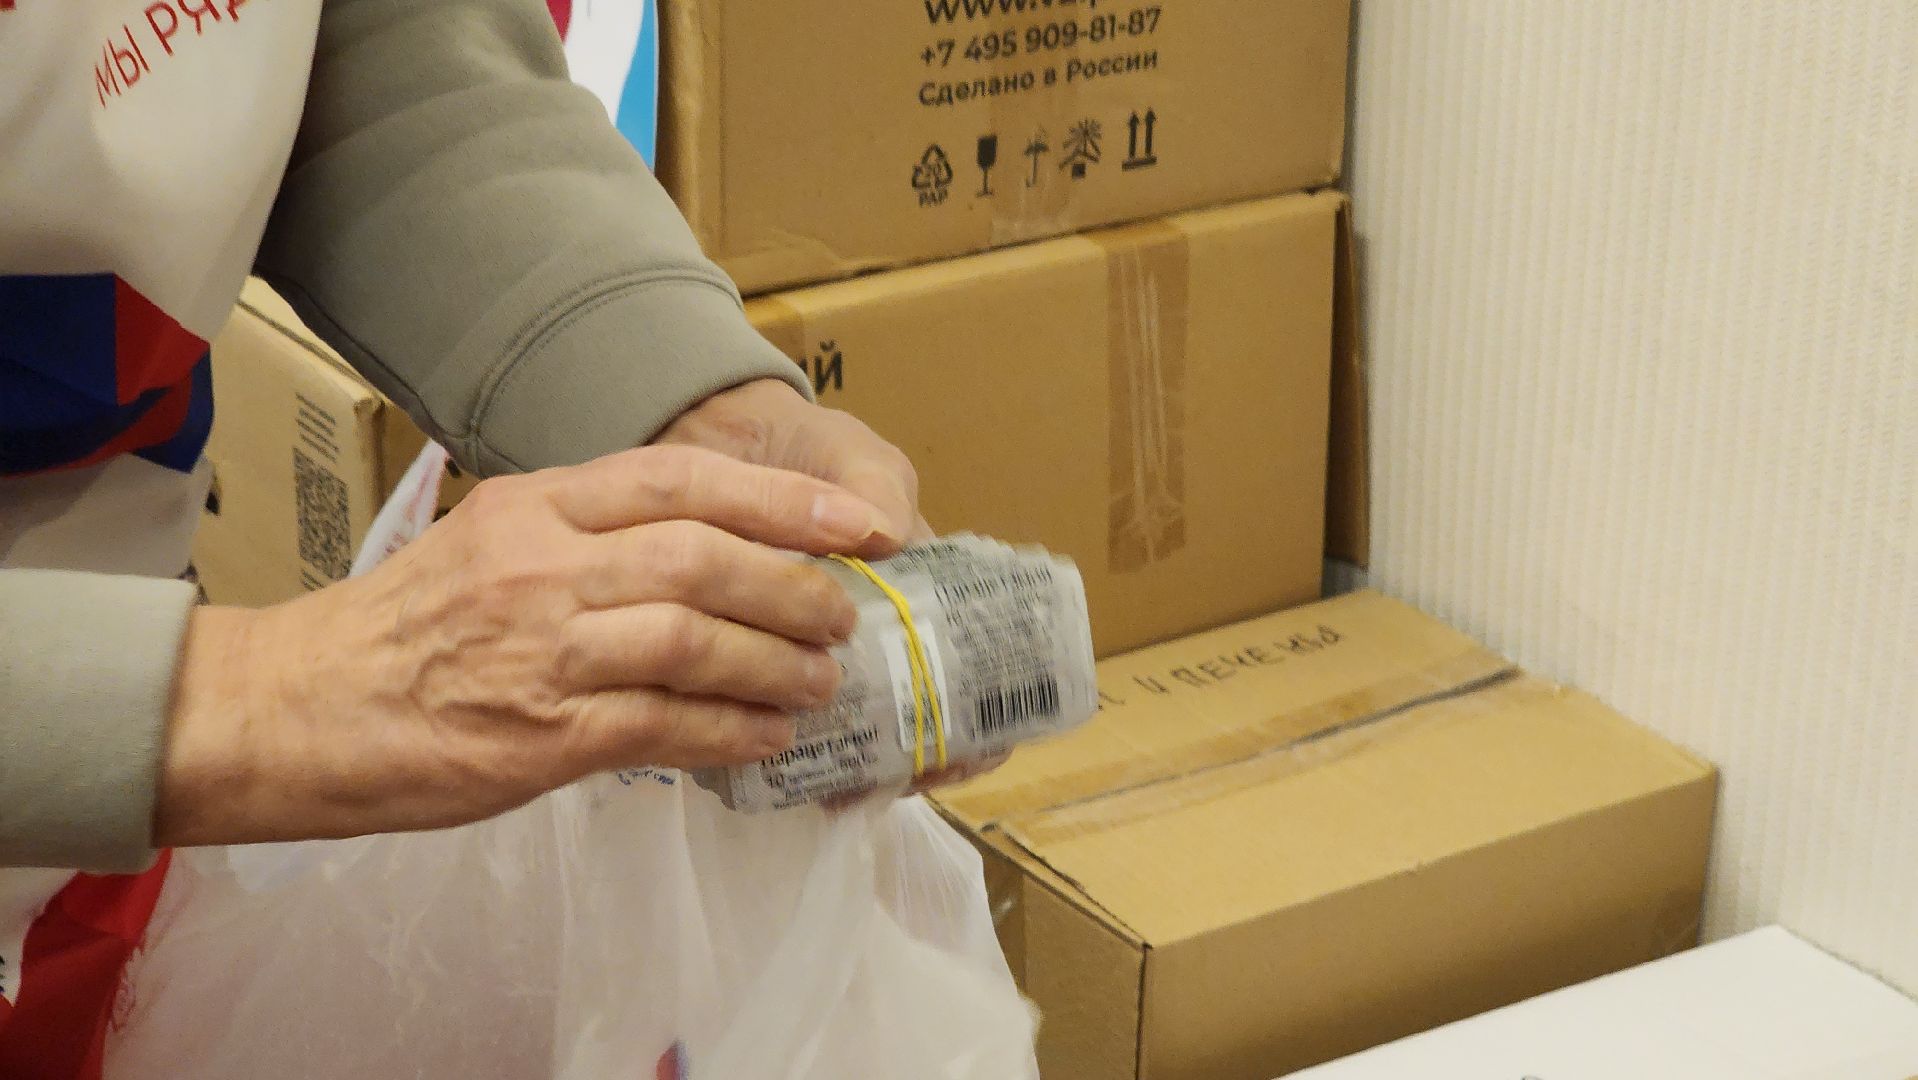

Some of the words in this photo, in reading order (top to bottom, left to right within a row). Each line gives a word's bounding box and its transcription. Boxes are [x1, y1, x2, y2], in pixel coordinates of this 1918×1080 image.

[920, 38, 955, 67] +7
[964, 27, 1018, 63] 495
[1025, 6, 1162, 54] 909-81-87
[918, 71, 1035, 107] Сделано
[1043, 66, 1057, 88] в
[1066, 49, 1158, 84] России
